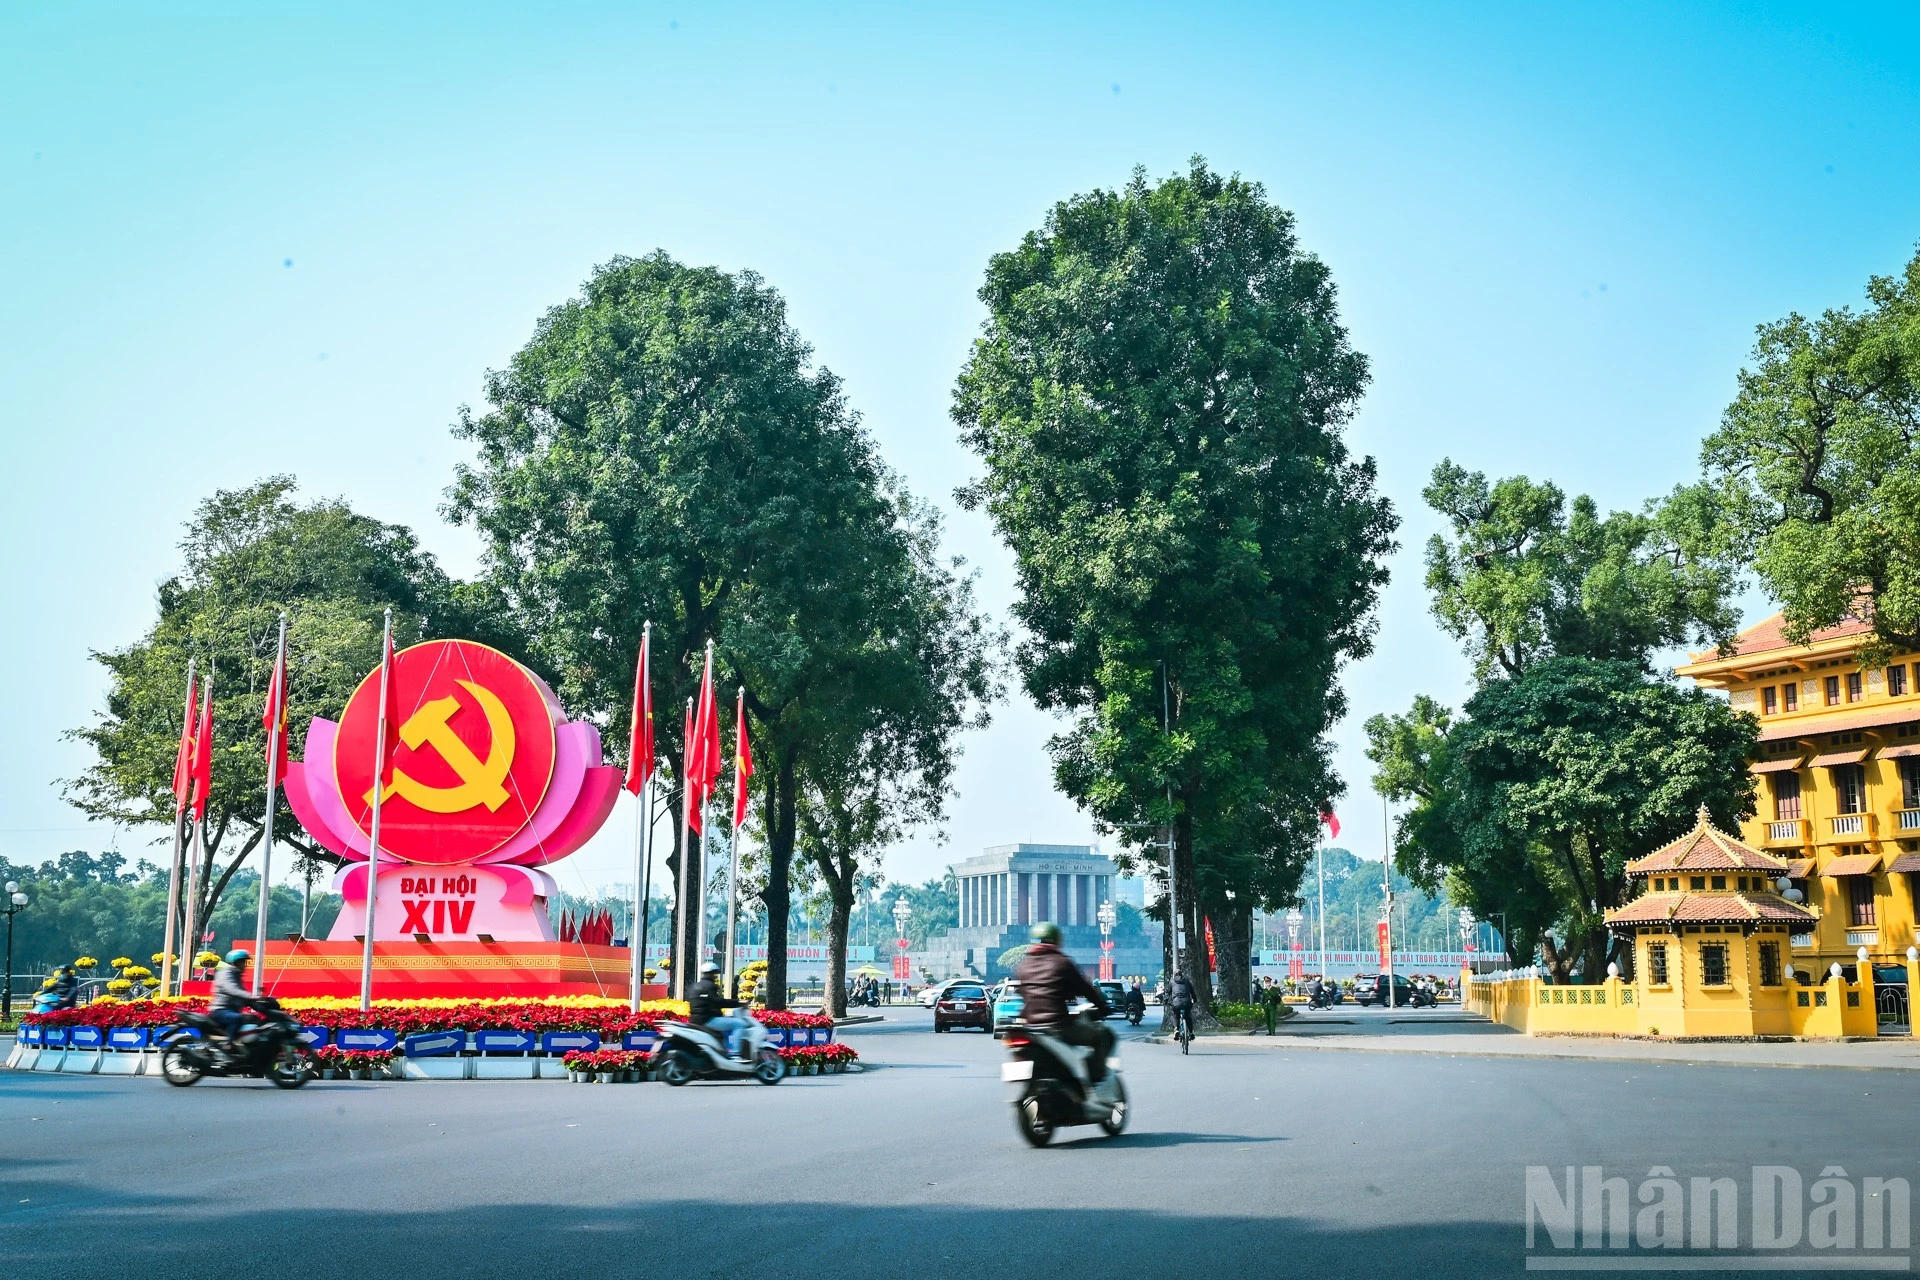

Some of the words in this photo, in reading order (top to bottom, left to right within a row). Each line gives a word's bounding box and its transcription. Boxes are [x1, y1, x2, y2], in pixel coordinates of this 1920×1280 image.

[401, 877, 436, 897] ĐẠI
[442, 874, 477, 897] HỘI
[399, 900, 476, 934] XIV
[1334, 954, 1353, 963] MINH
[1415, 954, 1438, 963] TRONG
